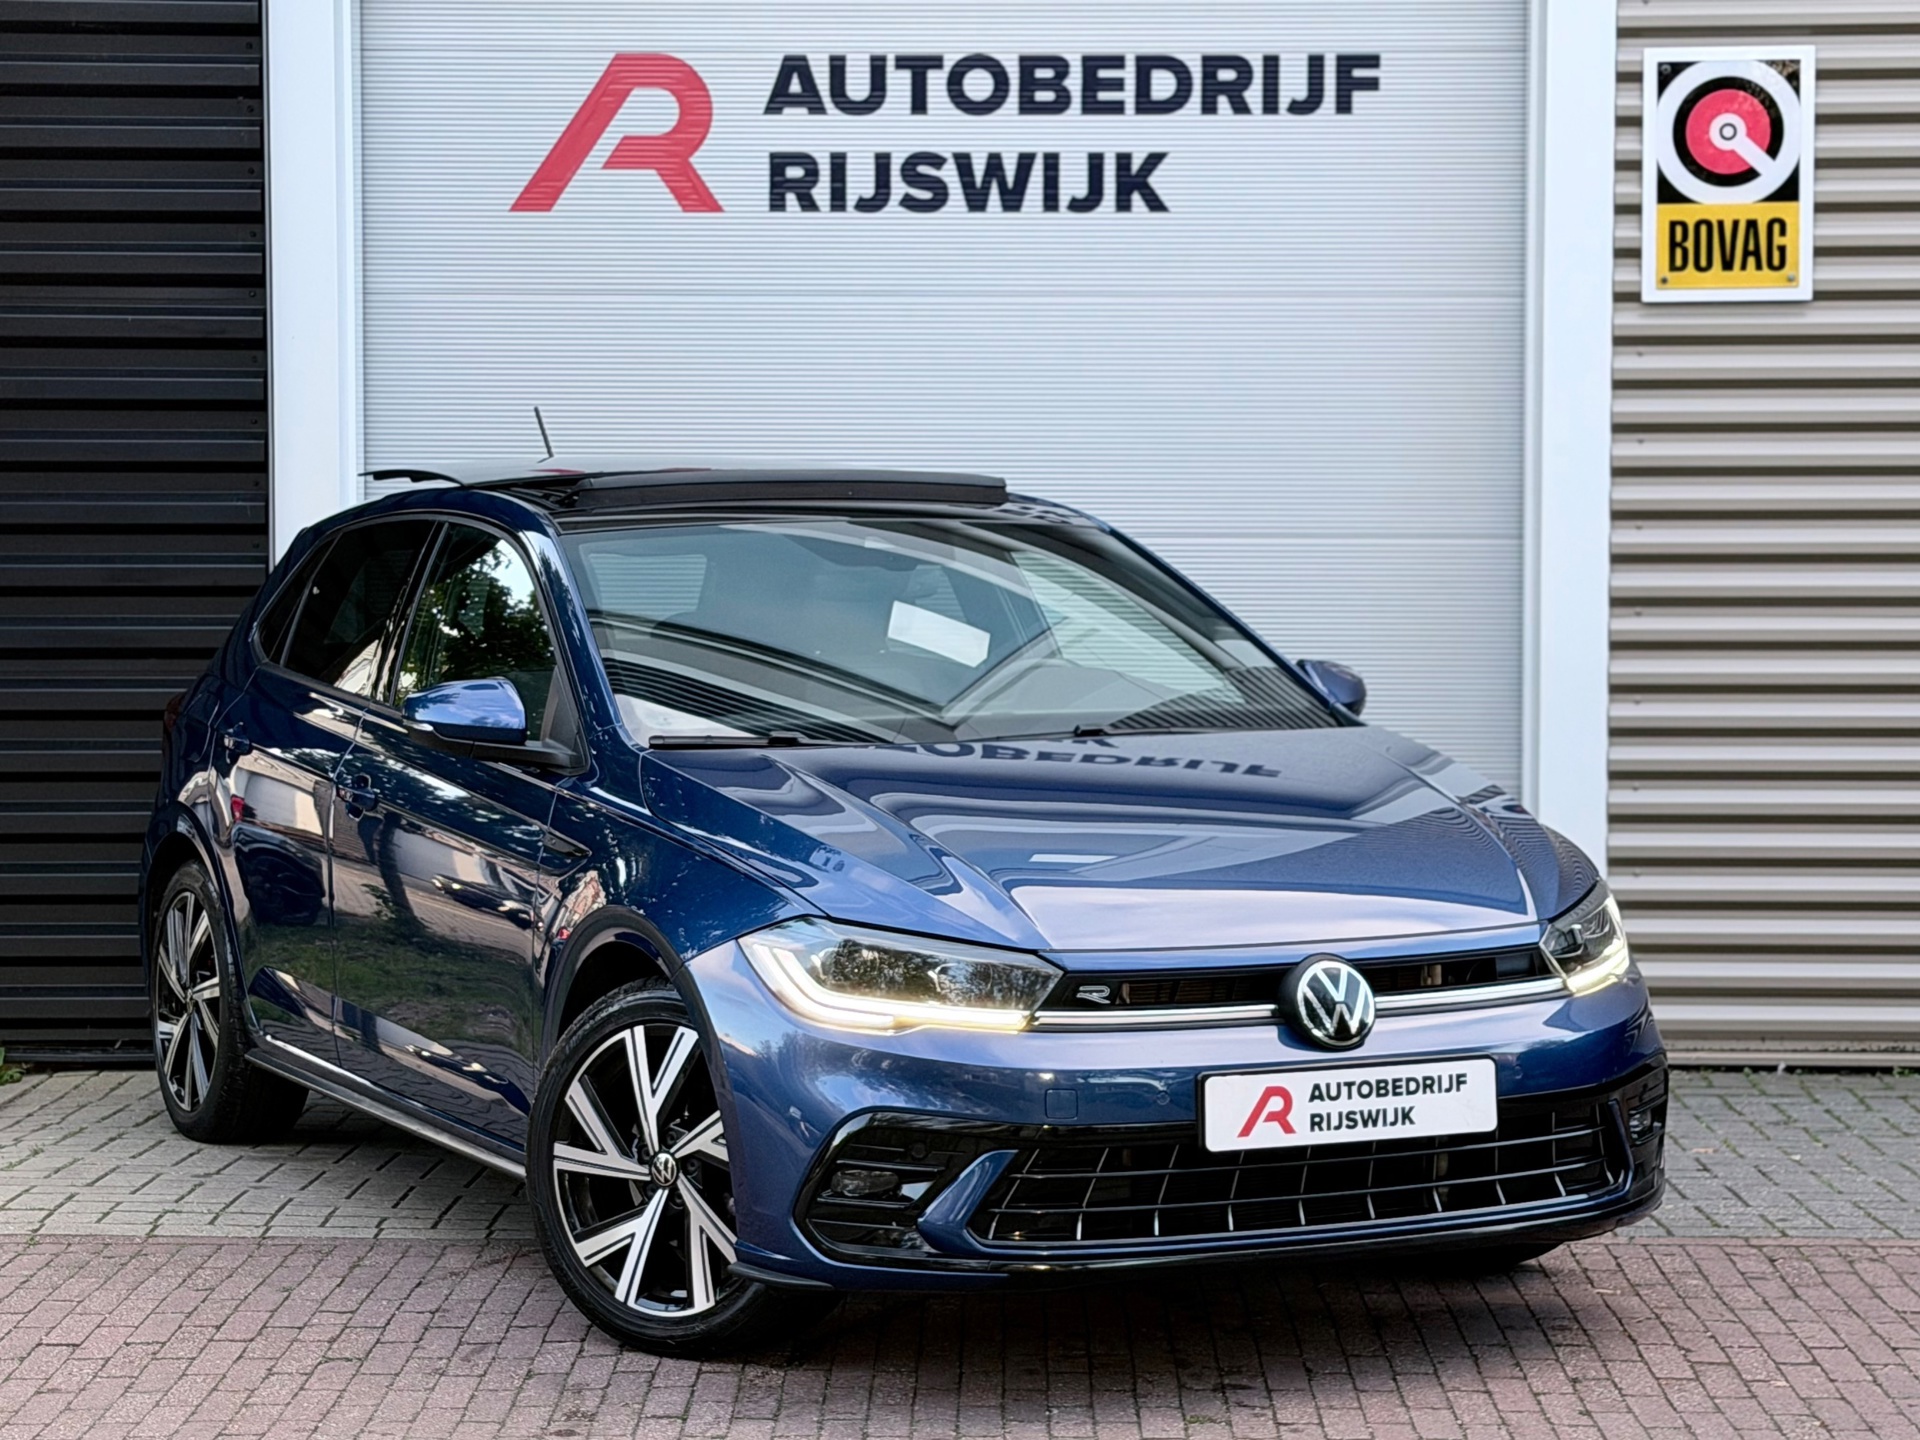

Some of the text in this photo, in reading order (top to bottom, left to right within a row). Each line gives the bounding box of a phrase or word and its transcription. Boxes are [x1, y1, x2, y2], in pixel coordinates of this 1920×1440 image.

[764, 53, 1381, 116] AUTOBEDRIJF
[769, 152, 1170, 213] RIJSWIJK
[1668, 217, 1787, 273] BOVAG
[1309, 1073, 1468, 1103] AUTOBEDRIJF
[1310, 1106, 1416, 1132] RIJSWIJK
